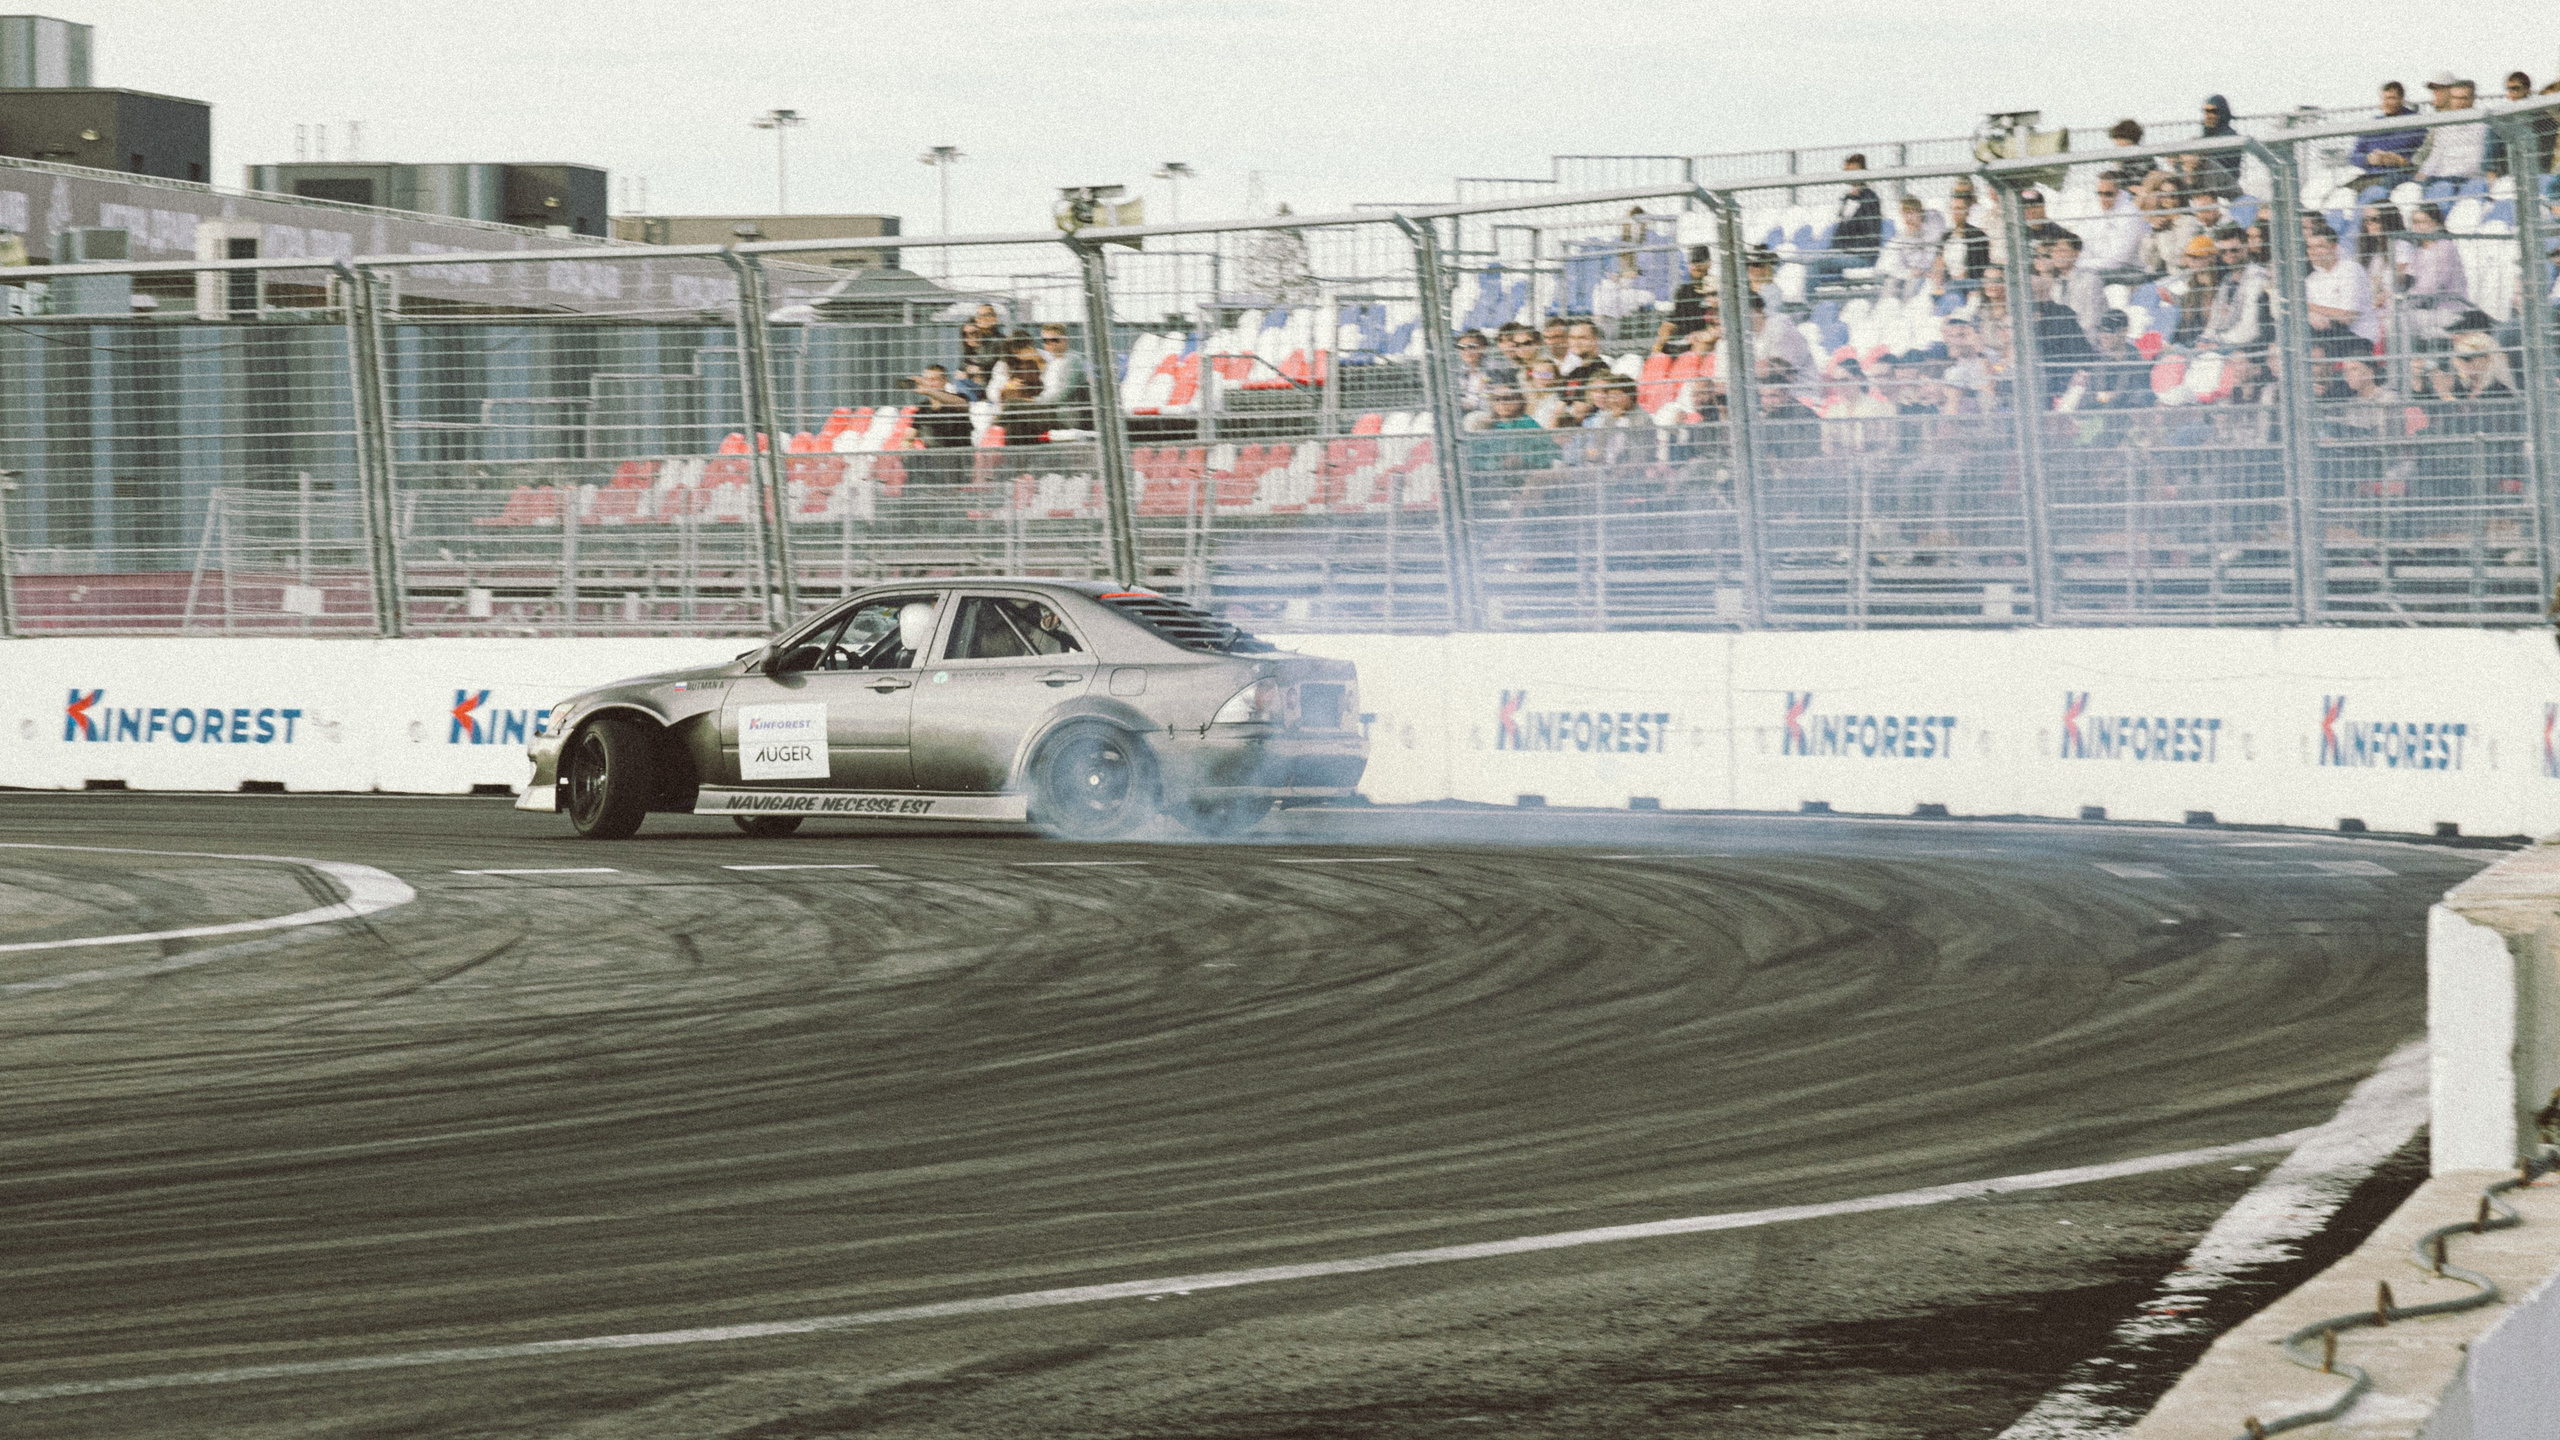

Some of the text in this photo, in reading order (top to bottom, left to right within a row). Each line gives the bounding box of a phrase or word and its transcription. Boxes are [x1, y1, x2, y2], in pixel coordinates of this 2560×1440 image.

[63, 688, 302, 744] KINFOREST
[749, 718, 812, 730] KINFOREST
[1496, 689, 1671, 754] KINFOREST
[1781, 690, 1957, 758] KINFOREST
[2060, 690, 2221, 763] KINFOREST
[2318, 694, 2468, 770] KINFOREST
[755, 746, 813, 762] AUGER
[725, 795, 936, 814] NAVIGARE NECESSE EST
